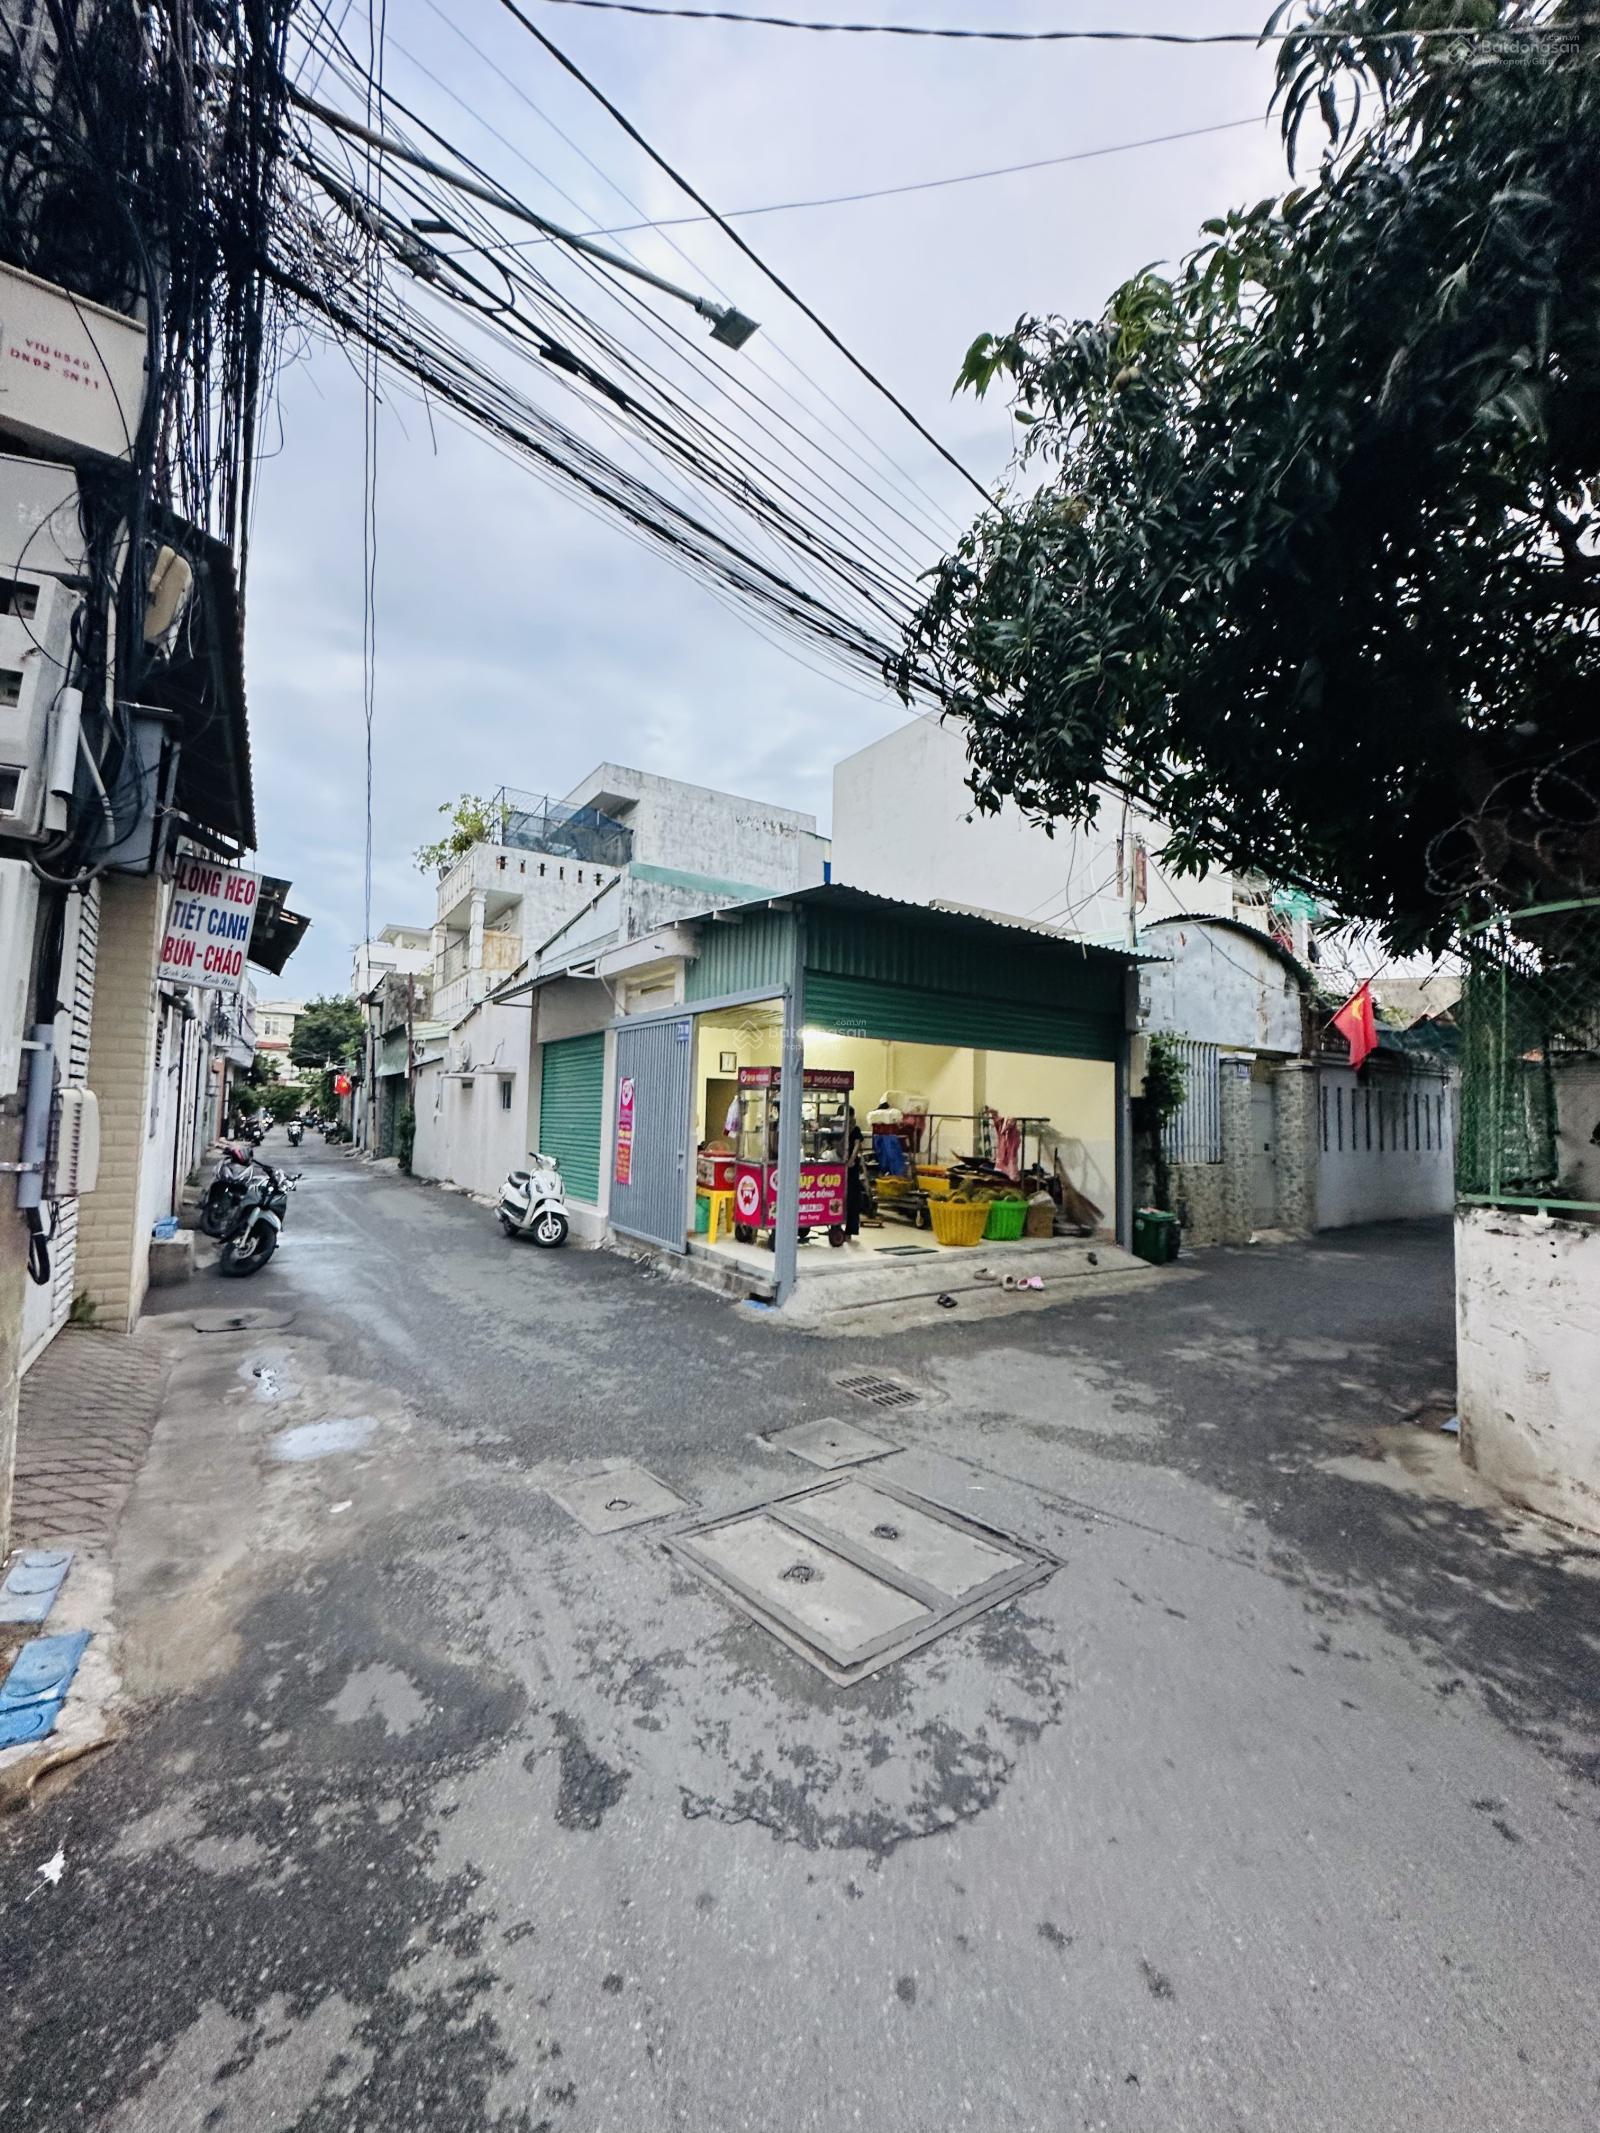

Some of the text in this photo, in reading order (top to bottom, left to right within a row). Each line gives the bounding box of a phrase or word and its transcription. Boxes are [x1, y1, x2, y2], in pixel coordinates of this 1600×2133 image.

[224, 875, 256, 906] HEO
[172, 897, 250, 941] TIẾT CANH
[162, 934, 196, 967] BÚN
[203, 944, 243, 976] CHÁO
